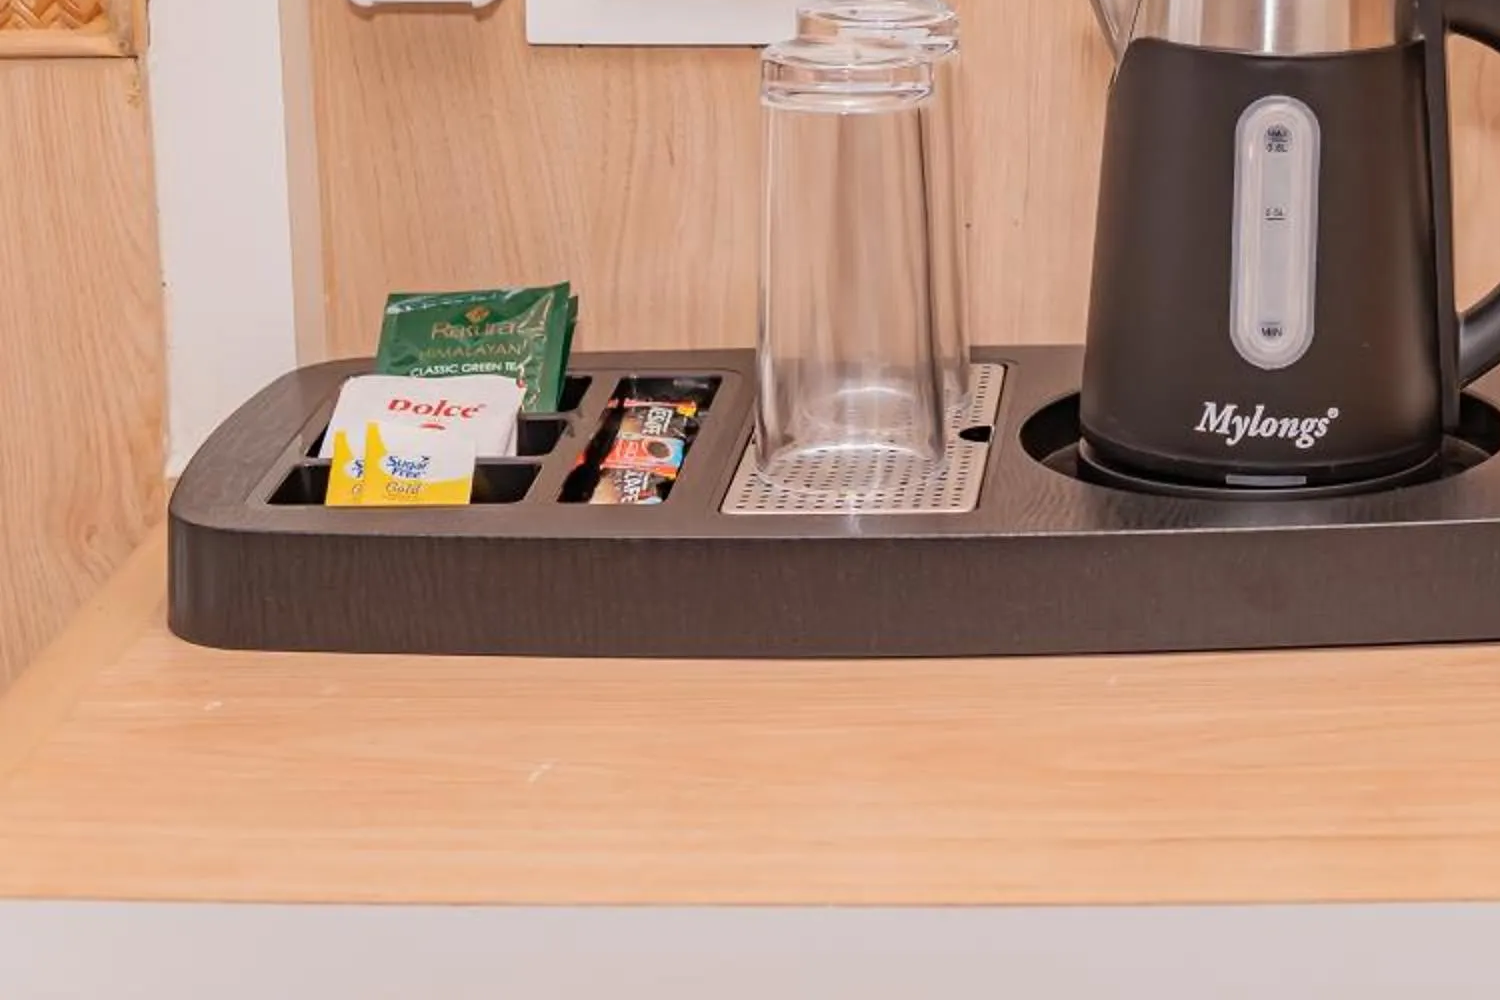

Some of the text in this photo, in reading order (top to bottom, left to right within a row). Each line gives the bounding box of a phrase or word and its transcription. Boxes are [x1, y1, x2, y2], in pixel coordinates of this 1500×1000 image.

[409, 362, 458, 378] CLASSIC
[461, 361, 501, 374] GREEN
[387, 398, 480, 420] Dolce
[385, 455, 430, 471] Sugar
